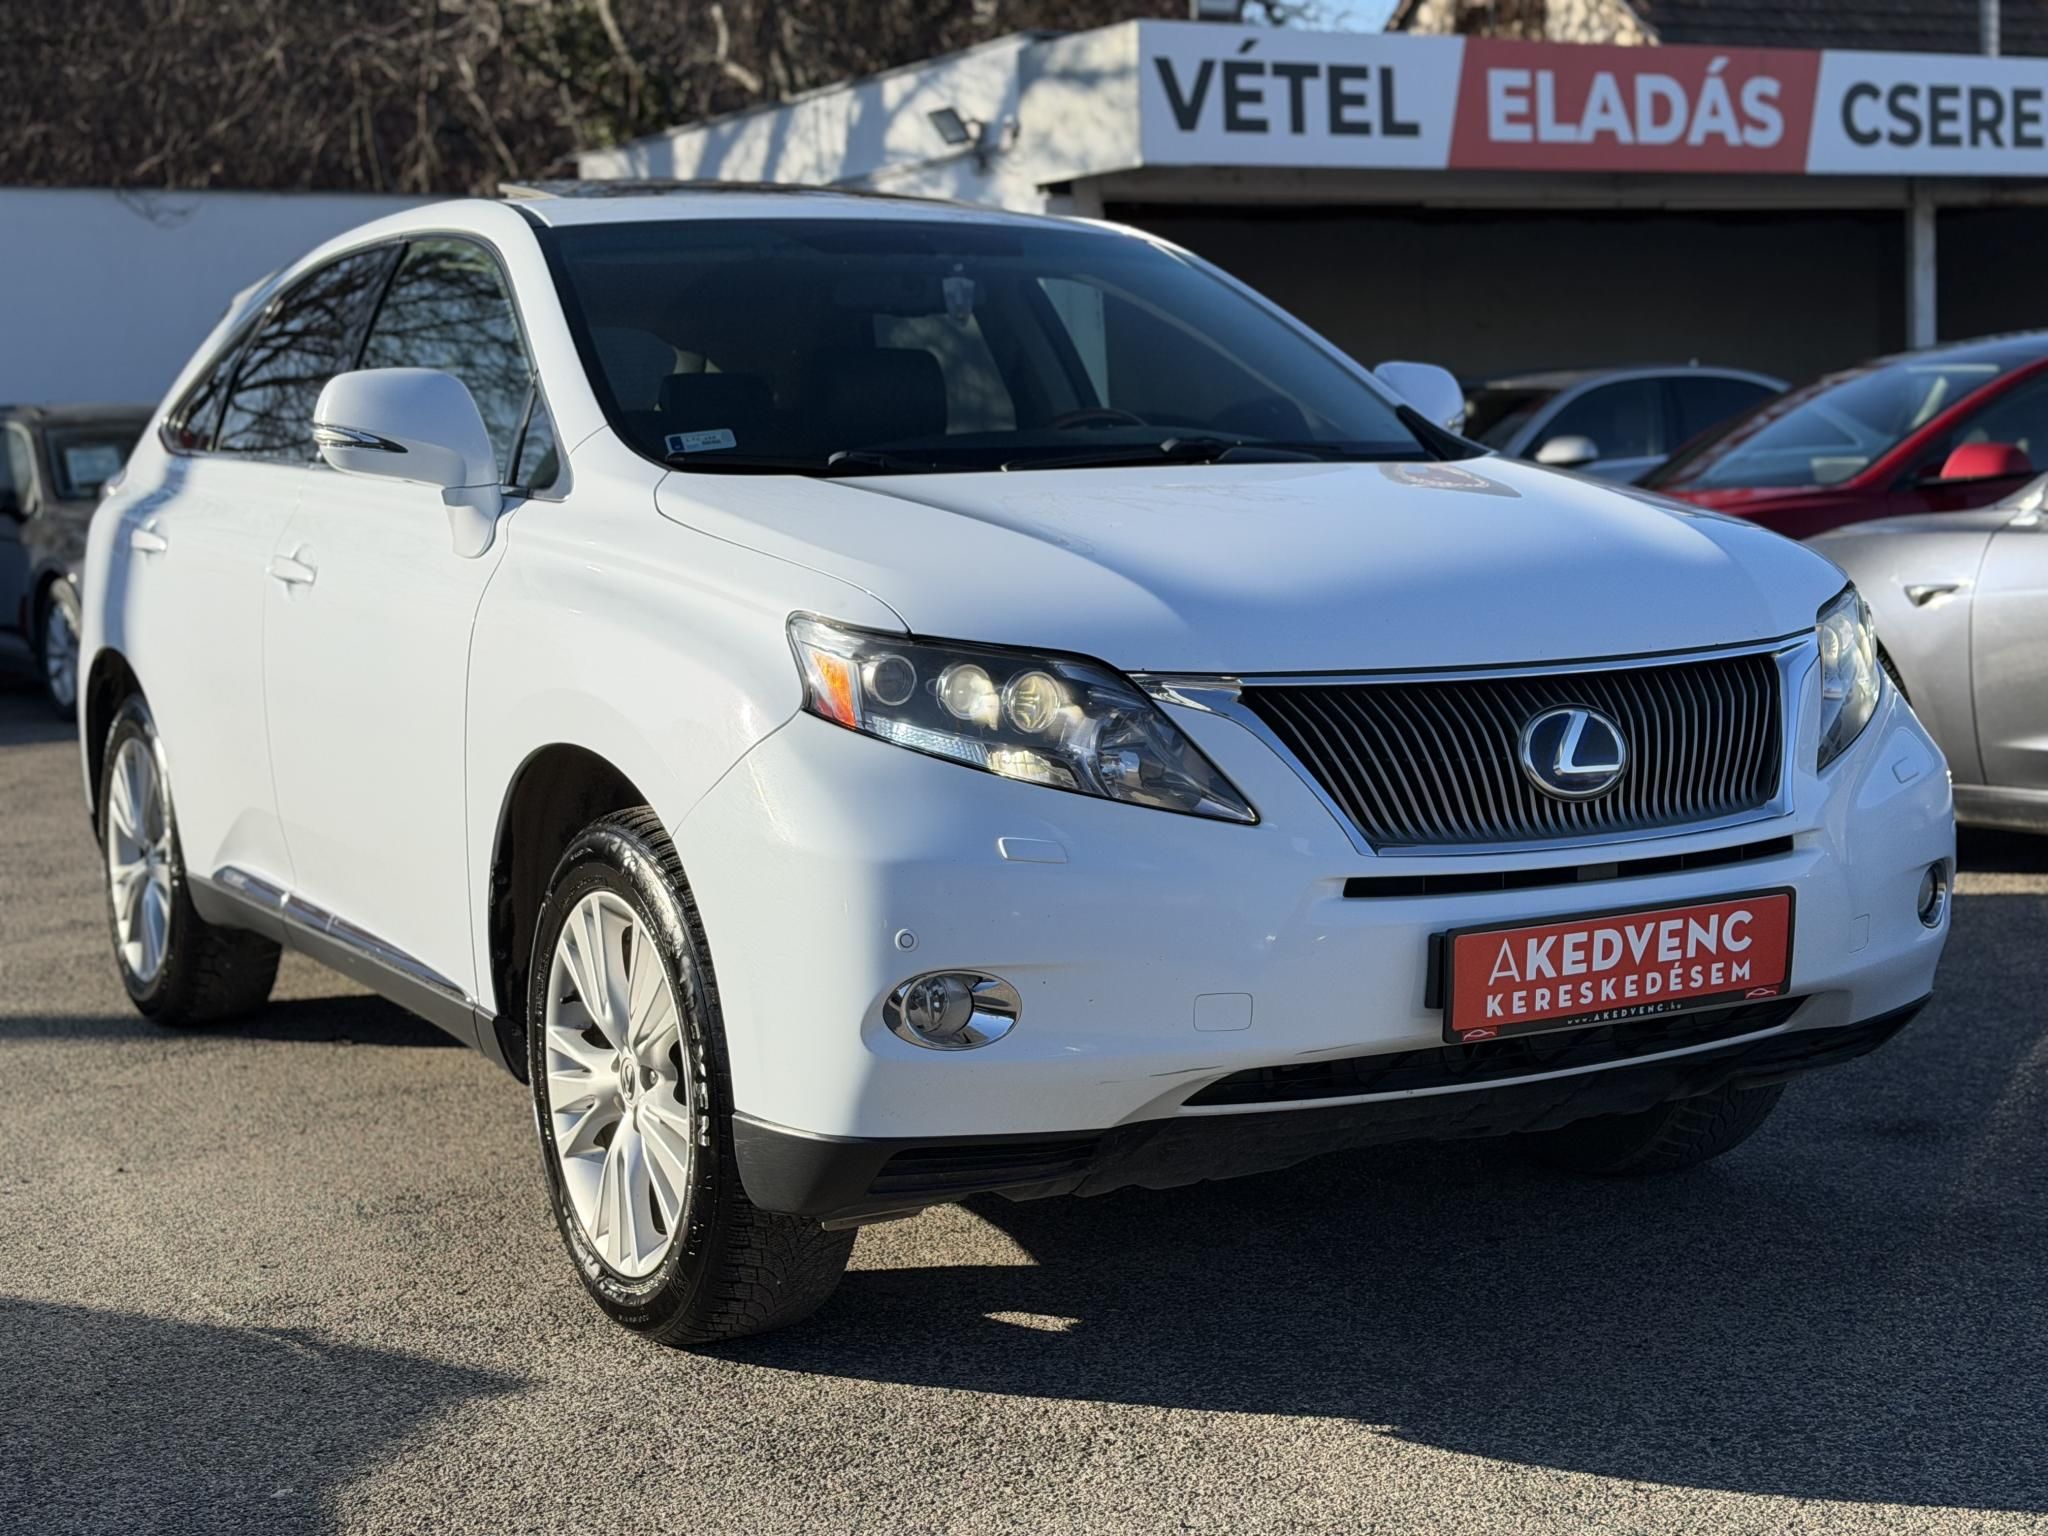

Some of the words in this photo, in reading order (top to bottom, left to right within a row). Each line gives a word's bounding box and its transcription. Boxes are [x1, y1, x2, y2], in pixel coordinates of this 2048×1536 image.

[1153, 39, 1421, 138] VÉTEL
[1487, 55, 1785, 148] ELADÁS
[1841, 80, 2045, 148] CSERE
[1485, 957, 1751, 1019] KERESKEDÉSEM
